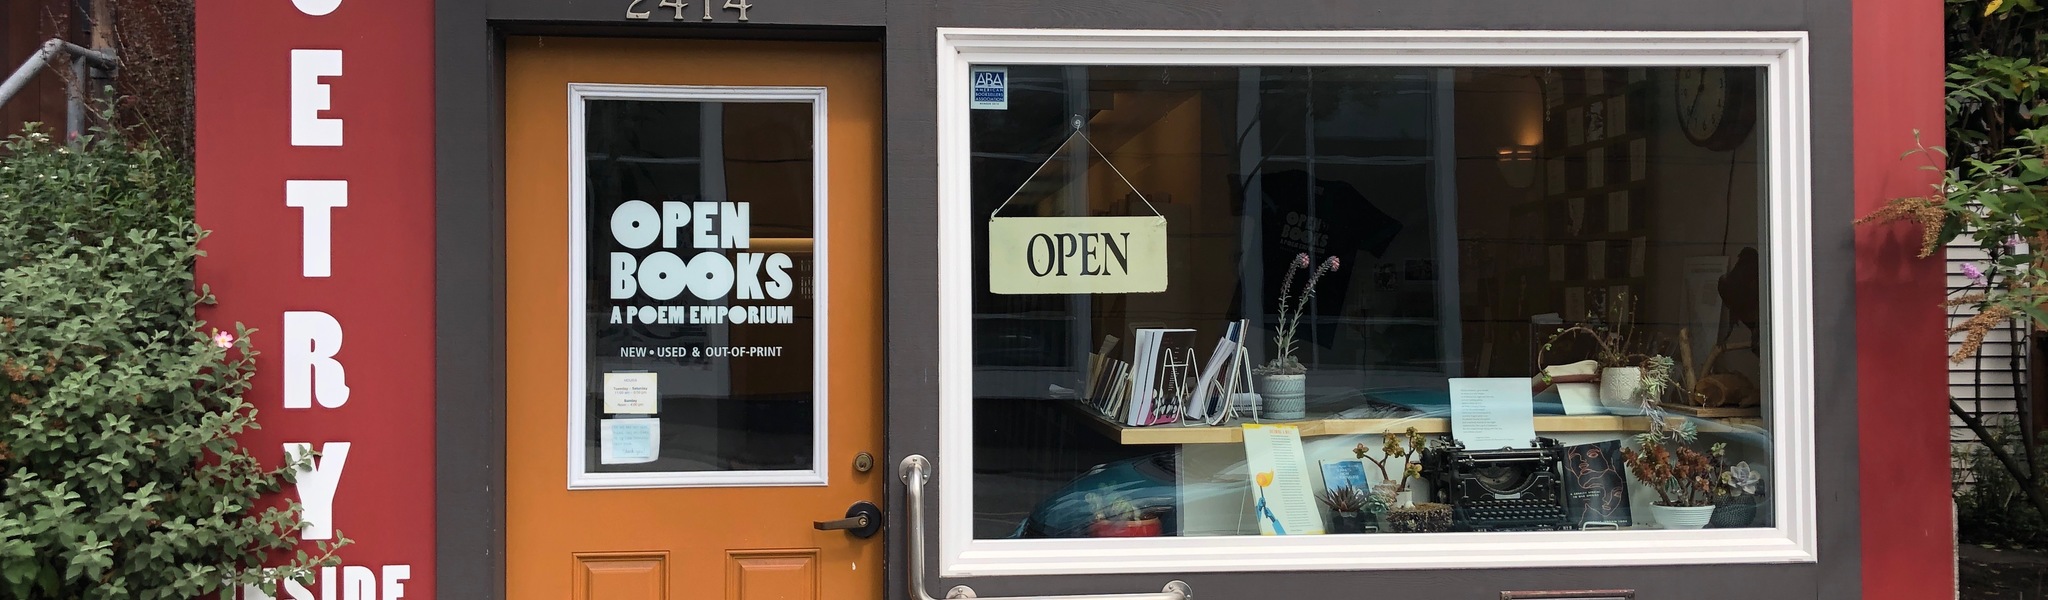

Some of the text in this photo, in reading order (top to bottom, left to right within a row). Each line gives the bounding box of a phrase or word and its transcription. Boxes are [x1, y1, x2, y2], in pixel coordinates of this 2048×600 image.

[976, 72, 1004, 87] ABA
[611, 200, 749, 249] OPEN
[283, 0, 350, 541] ETRY
[1027, 232, 1130, 278] OPEN
[611, 251, 793, 300] BOOKS
[611, 305, 793, 324] A POEM EMPORIUM
[620, 346, 647, 358] NEW
[657, 346, 687, 358] USED
[706, 346, 783, 358] OUT-OF-PRINT
[221, 565, 411, 600] SIDE
